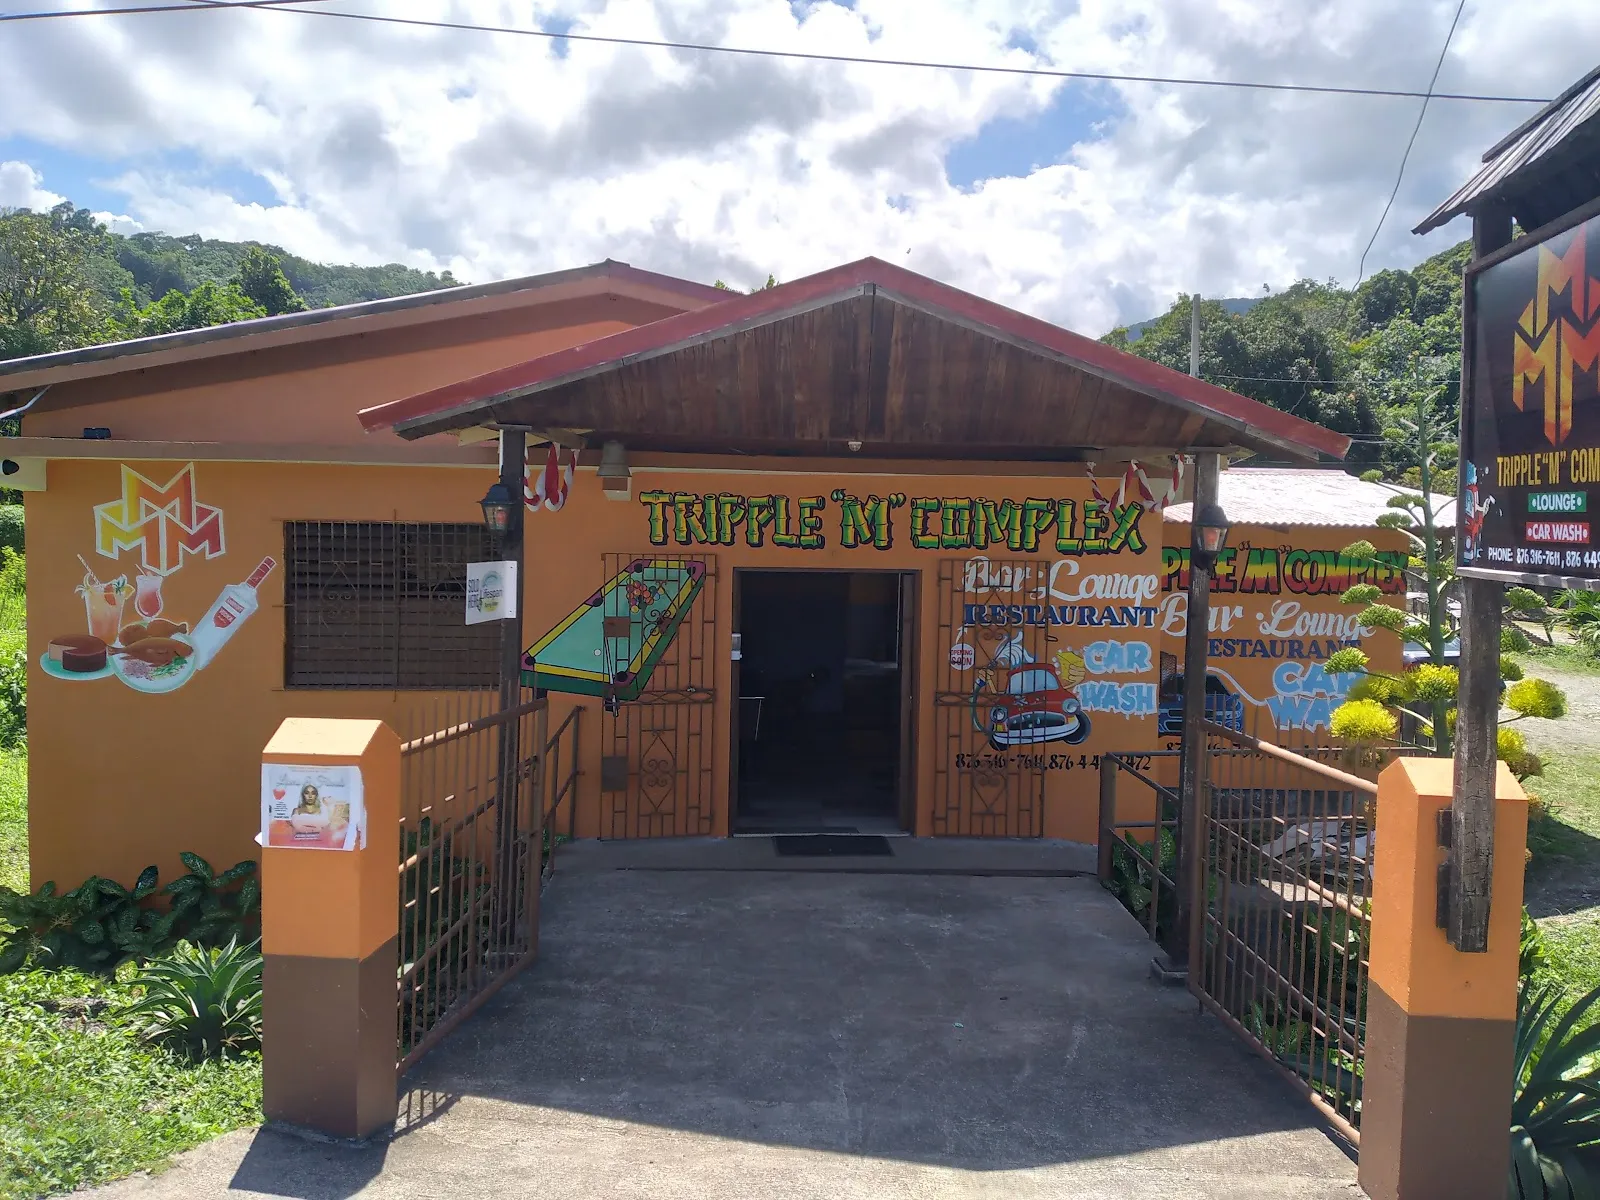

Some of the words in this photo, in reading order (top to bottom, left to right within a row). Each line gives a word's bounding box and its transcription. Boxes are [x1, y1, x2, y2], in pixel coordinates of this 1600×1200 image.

[1497, 453, 1541, 487] TRIPPLE
[1537, 493, 1576, 511] LOUNGE
[639, 490, 826, 550] TRIPPLE
[911, 497, 1147, 556] COMPLEX
[1532, 523, 1551, 540] CAR
[1552, 523, 1582, 541] WASH
[1488, 546, 1513, 562] PHONE:
[1516, 548, 1528, 564] 876
[1566, 551, 1581, 568] 876
[961, 555, 1032, 594] Bar
[1030, 559, 1159, 607] Lounge
[964, 603, 1160, 628] RESTAURANT
[951, 656, 972, 666] SOON
[1083, 640, 1153, 675] CAR
[1074, 681, 1158, 717] WASH
